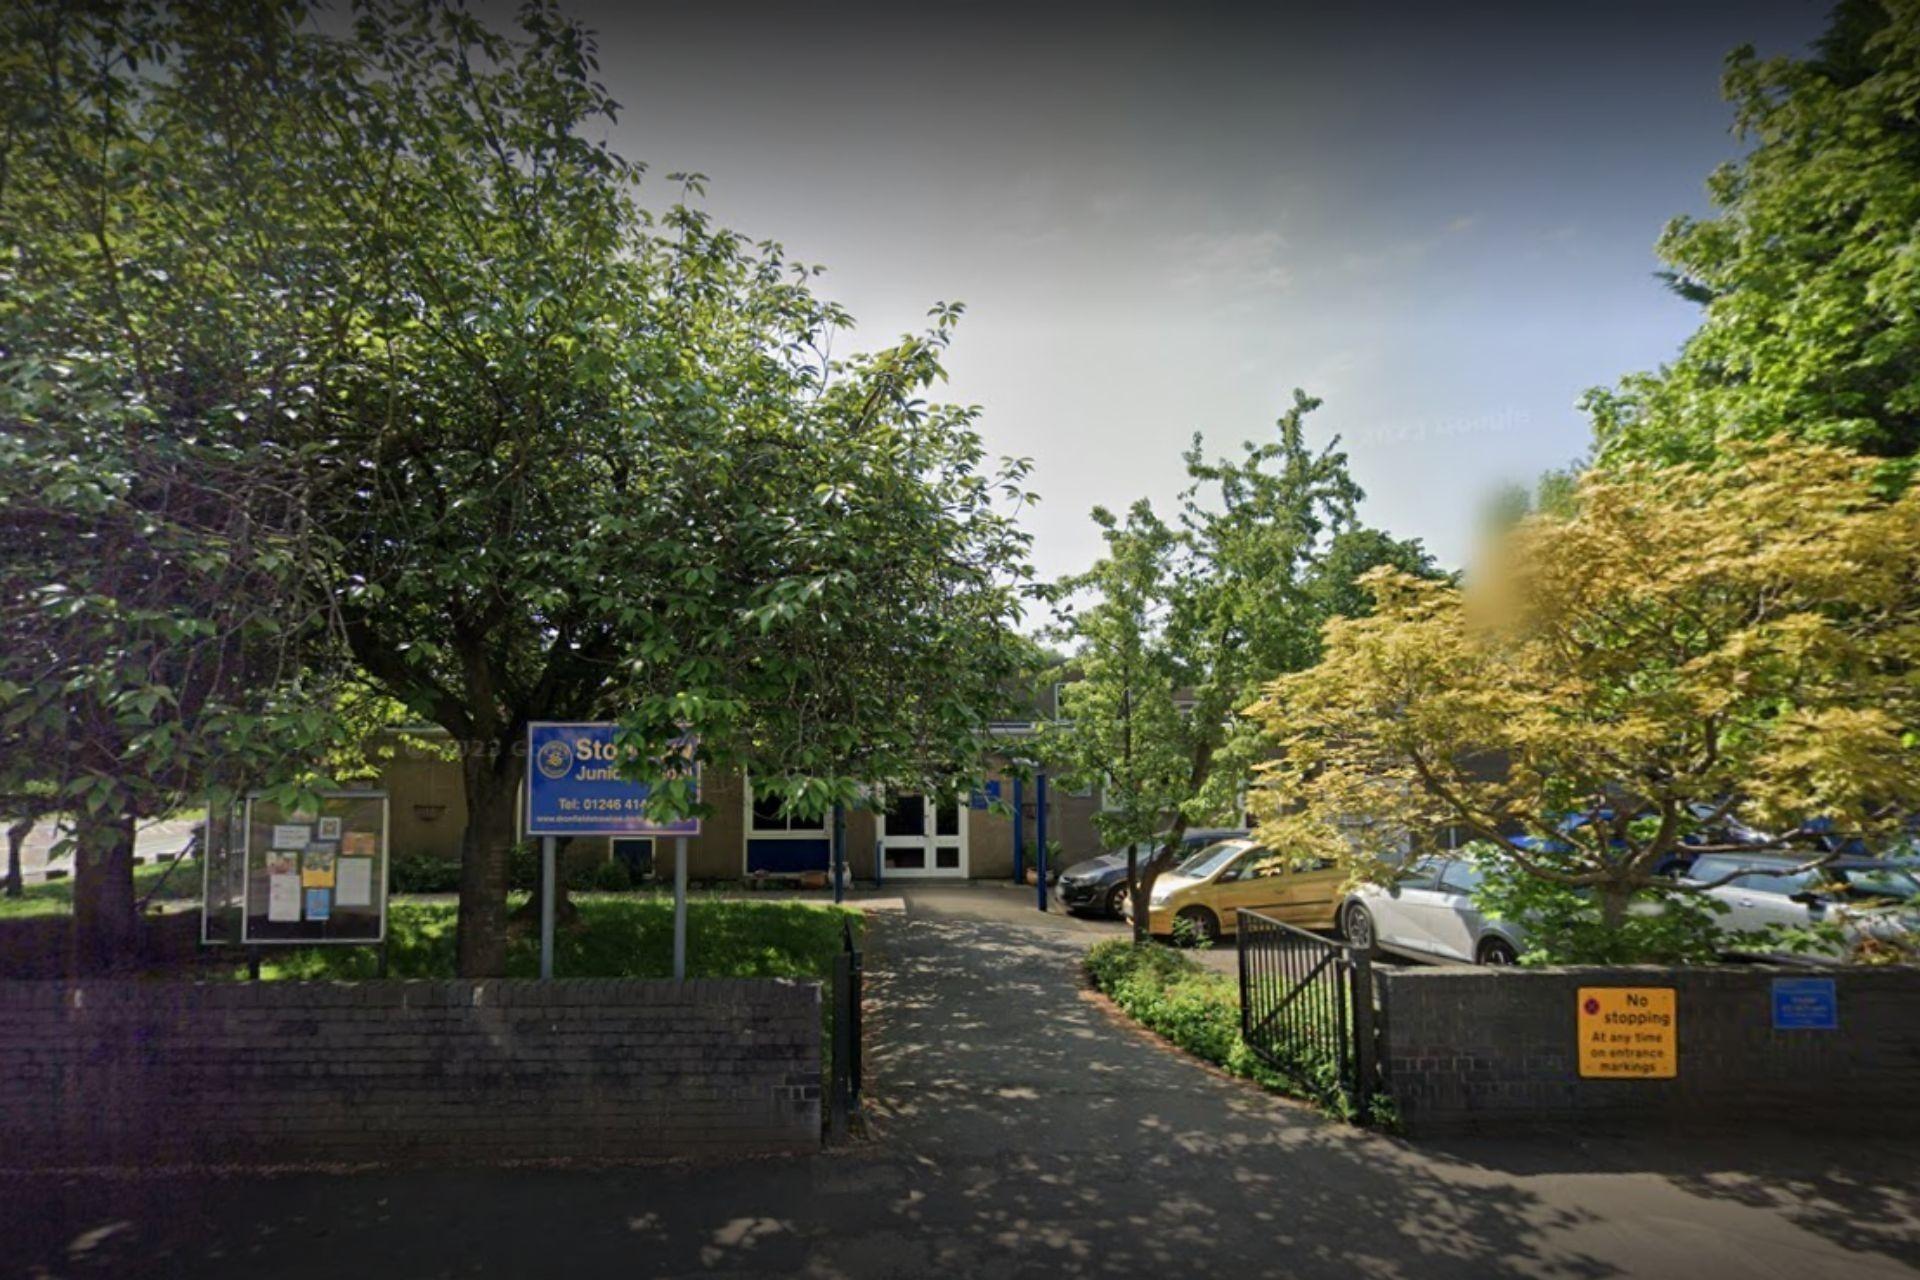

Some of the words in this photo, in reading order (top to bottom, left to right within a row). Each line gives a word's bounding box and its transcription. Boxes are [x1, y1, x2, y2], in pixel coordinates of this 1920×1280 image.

[558, 798, 581, 811] Tel:
[583, 798, 622, 811] 01246
[1627, 993, 1649, 1008] No
[1604, 1010, 1671, 1027] stopping
[1592, 1031, 1606, 1043] At
[1610, 1034, 1631, 1045] any
[1634, 1032, 1663, 1043] time
[1590, 1048, 1606, 1058] on
[1610, 1048, 1664, 1059] entrance
[1600, 1062, 1657, 1074] markings
